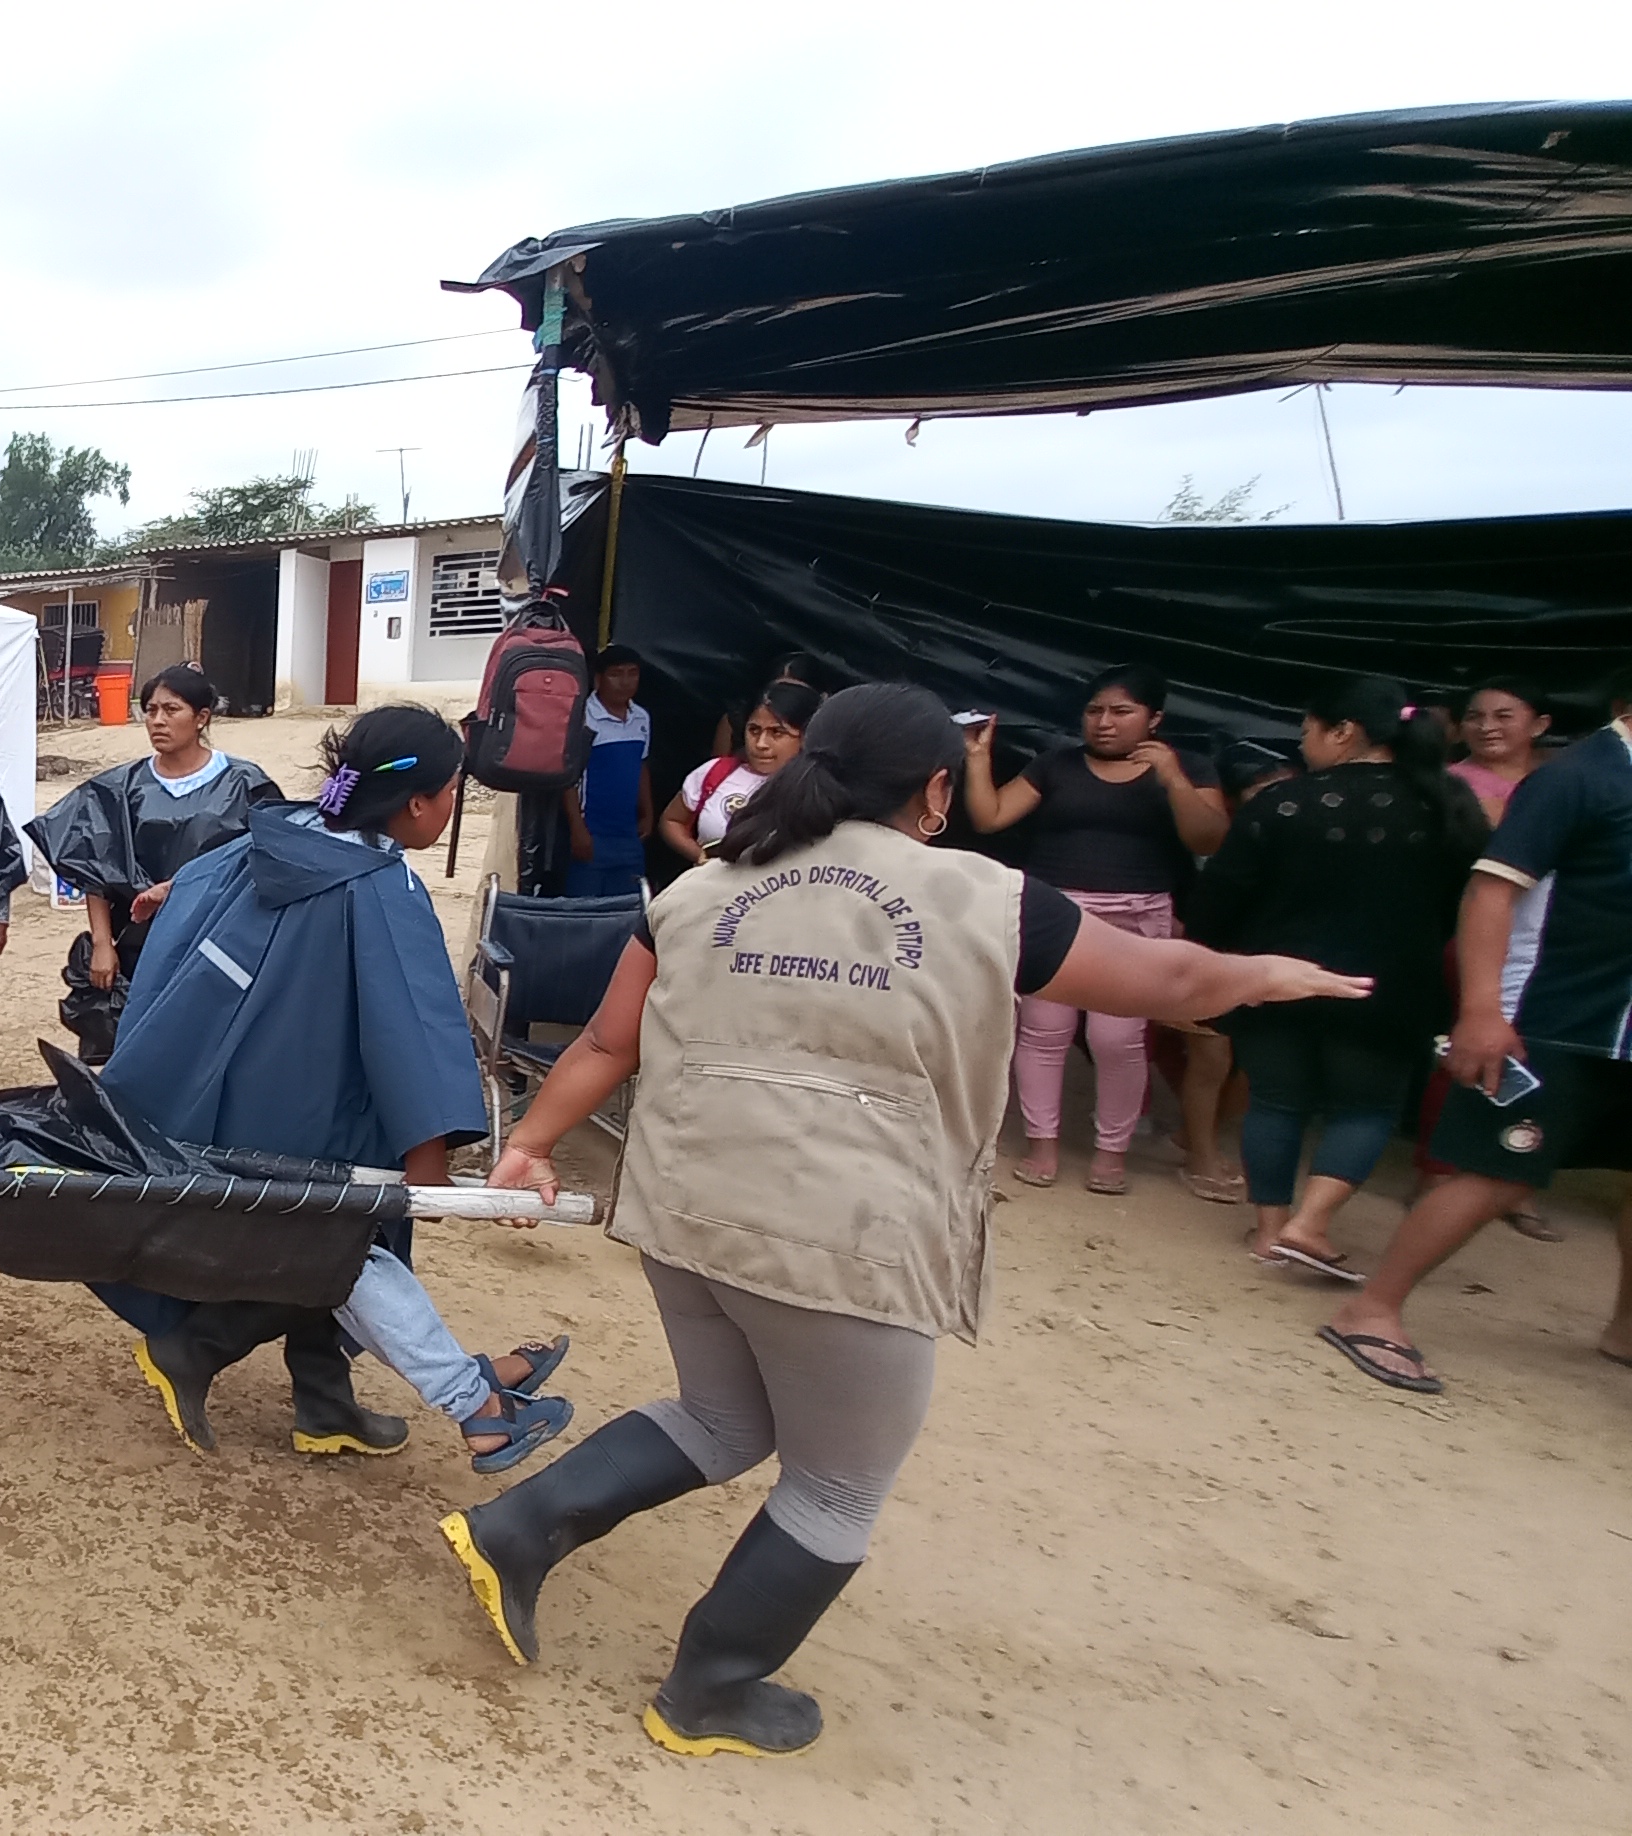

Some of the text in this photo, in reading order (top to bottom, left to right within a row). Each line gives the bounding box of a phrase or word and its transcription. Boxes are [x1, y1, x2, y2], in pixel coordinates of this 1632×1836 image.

[711, 865, 924, 970] MUNICIPALIDAD DISTRITAL DE PITIPO
[729, 952, 892, 991] JEFE DEFENSA CIVIL
